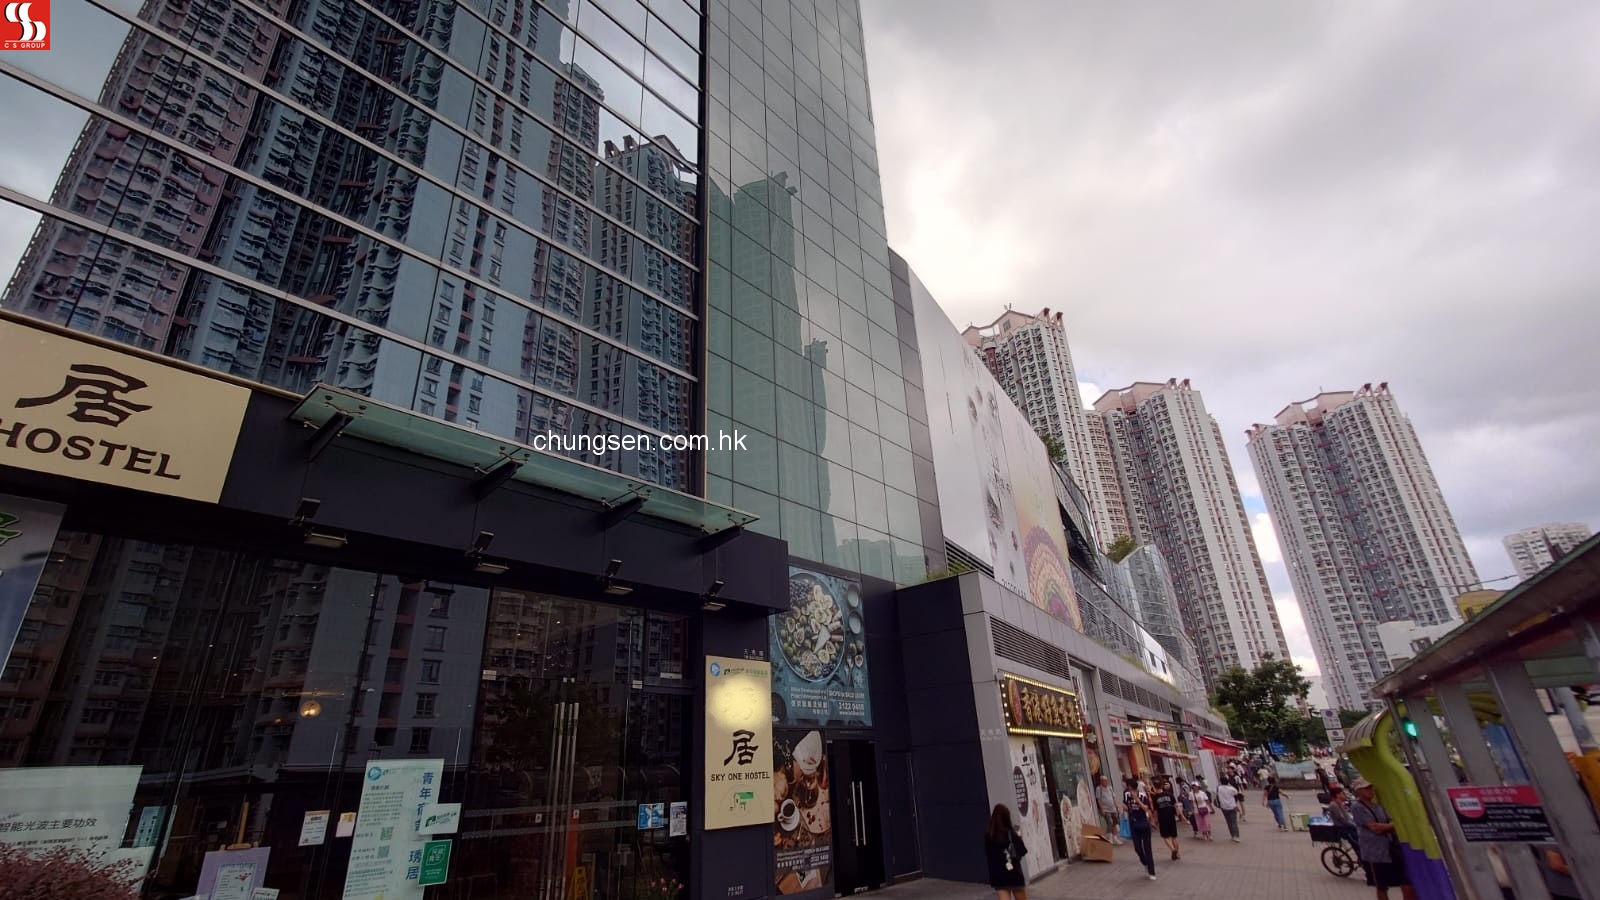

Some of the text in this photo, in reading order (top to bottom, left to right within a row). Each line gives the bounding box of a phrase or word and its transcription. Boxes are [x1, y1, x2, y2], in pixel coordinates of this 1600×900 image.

[14, 363, 153, 428] 居
[723, 729, 759, 766] 居
[711, 771, 771, 782] SKY ONE HOSTEL
